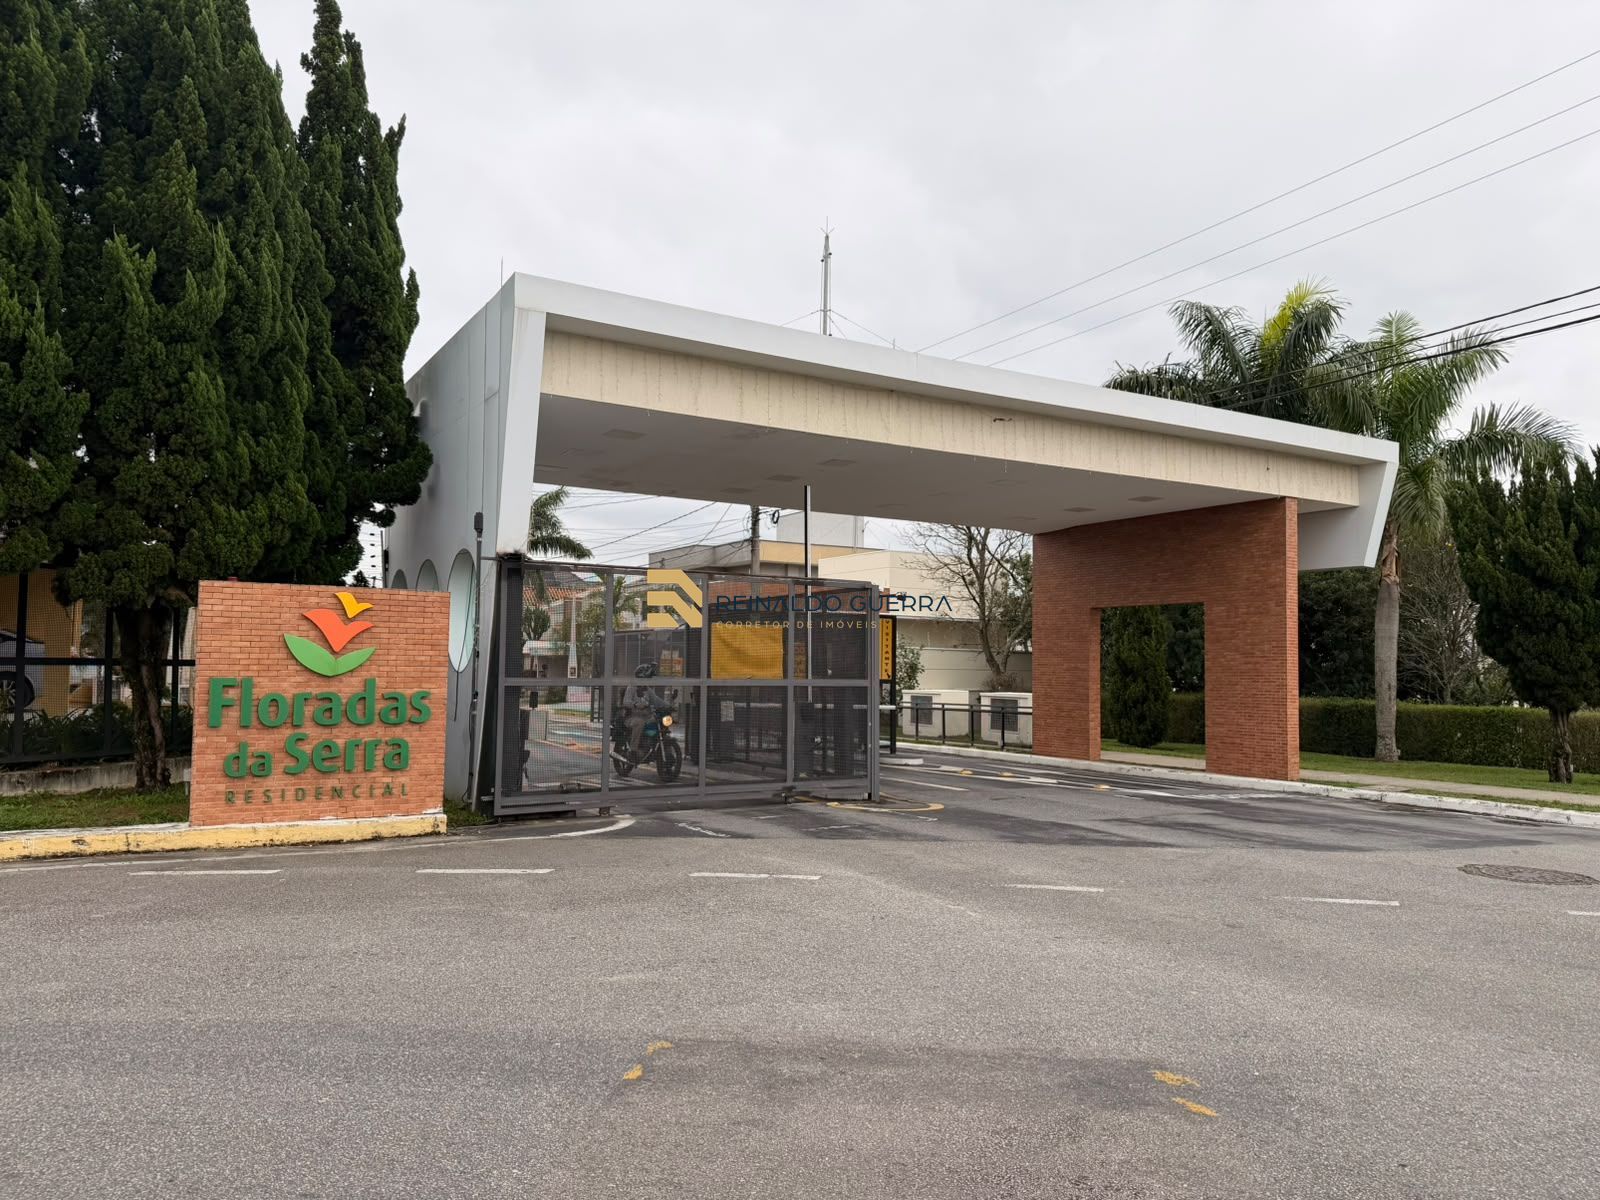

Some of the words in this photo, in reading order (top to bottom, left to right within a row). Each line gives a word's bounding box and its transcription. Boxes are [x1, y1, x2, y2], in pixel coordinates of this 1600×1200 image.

[208, 677, 432, 728] Floradas
[223, 742, 273, 778] da
[284, 732, 410, 775] Serra
[225, 783, 409, 804] RESIDENCIAL
